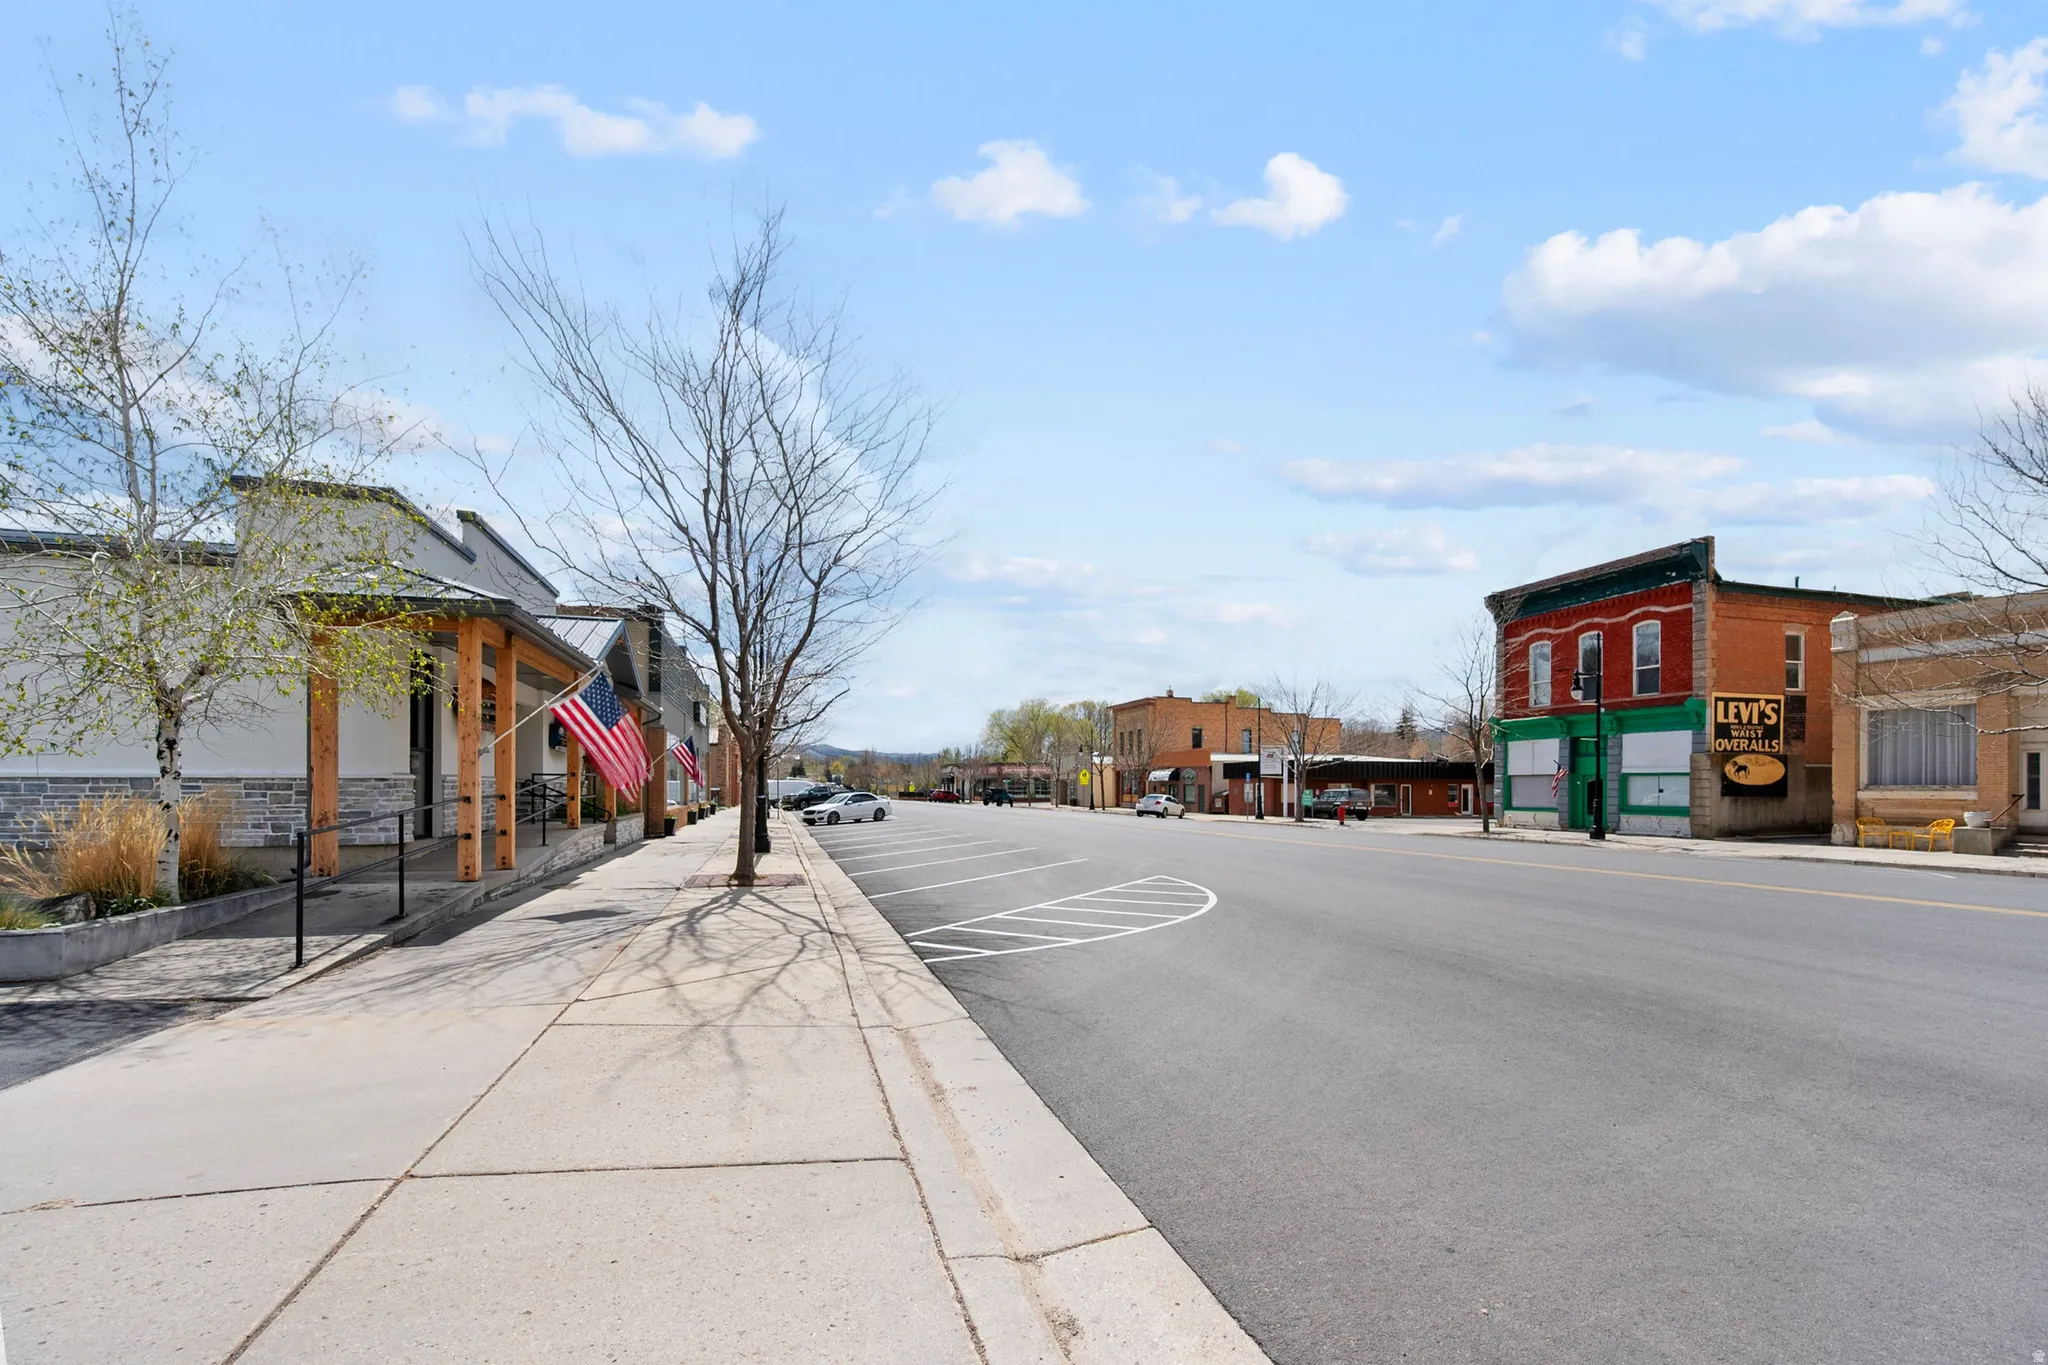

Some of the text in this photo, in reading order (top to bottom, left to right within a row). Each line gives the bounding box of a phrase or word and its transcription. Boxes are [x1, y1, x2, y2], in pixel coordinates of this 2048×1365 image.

[1717, 699, 1778, 725] LEVI'S
[1731, 730, 1763, 738] WAIST
[1715, 738, 1779, 752] OVERALLS
